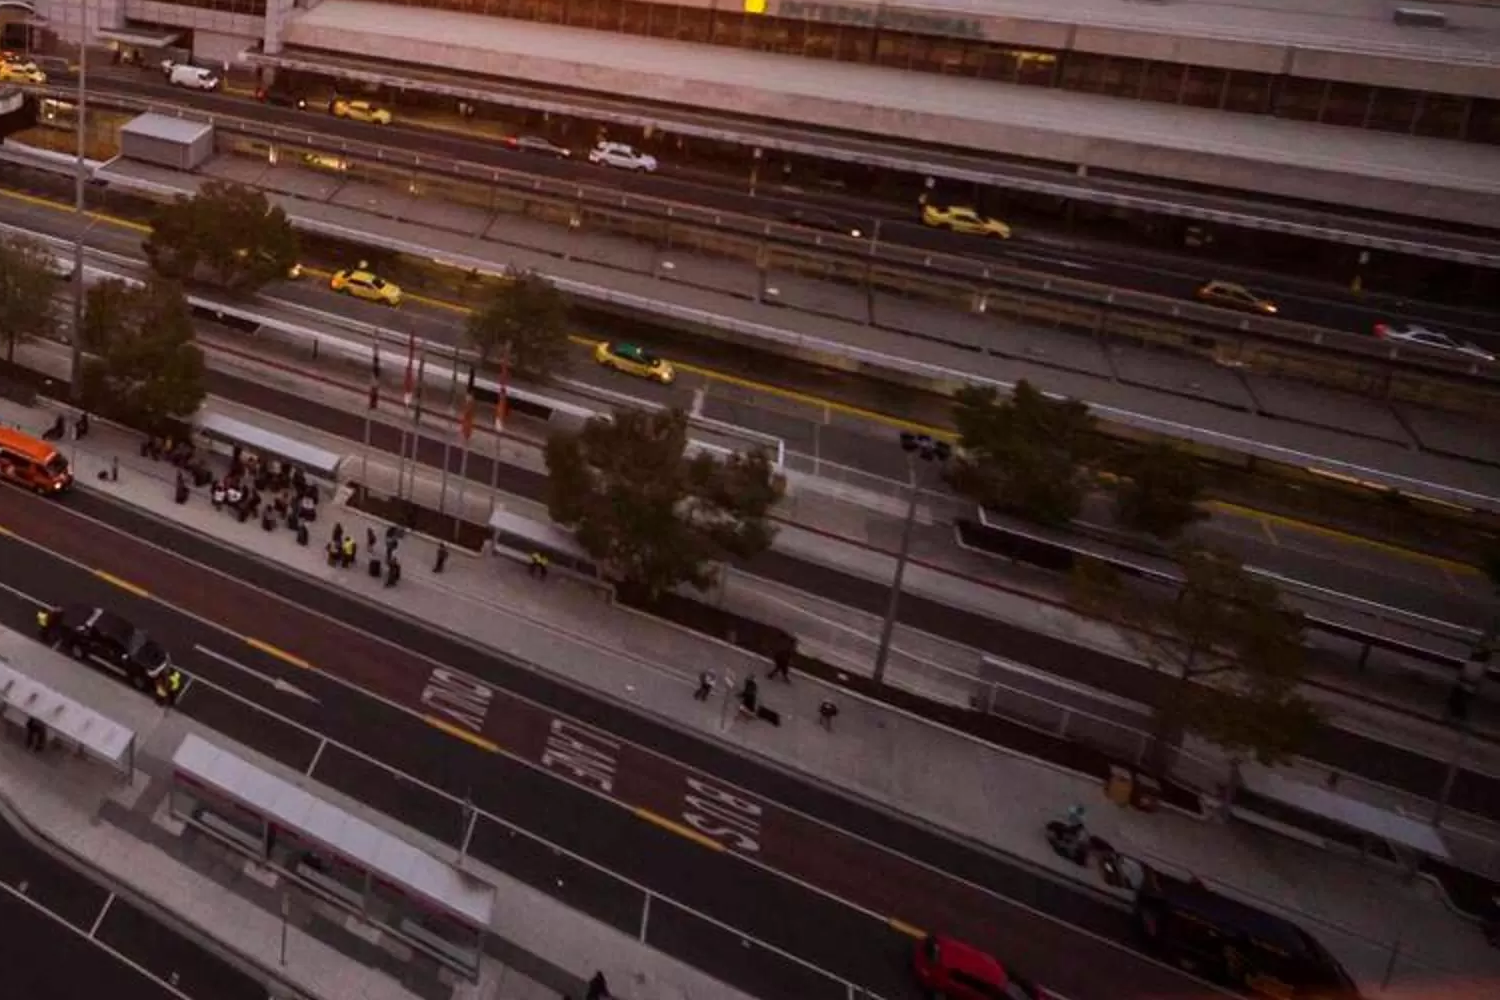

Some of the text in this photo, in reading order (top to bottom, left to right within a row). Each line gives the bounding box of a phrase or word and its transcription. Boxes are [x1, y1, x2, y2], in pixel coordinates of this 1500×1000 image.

[421, 667, 493, 733] ONLY
[542, 719, 620, 792] LANE
[683, 776, 762, 851] BUS
